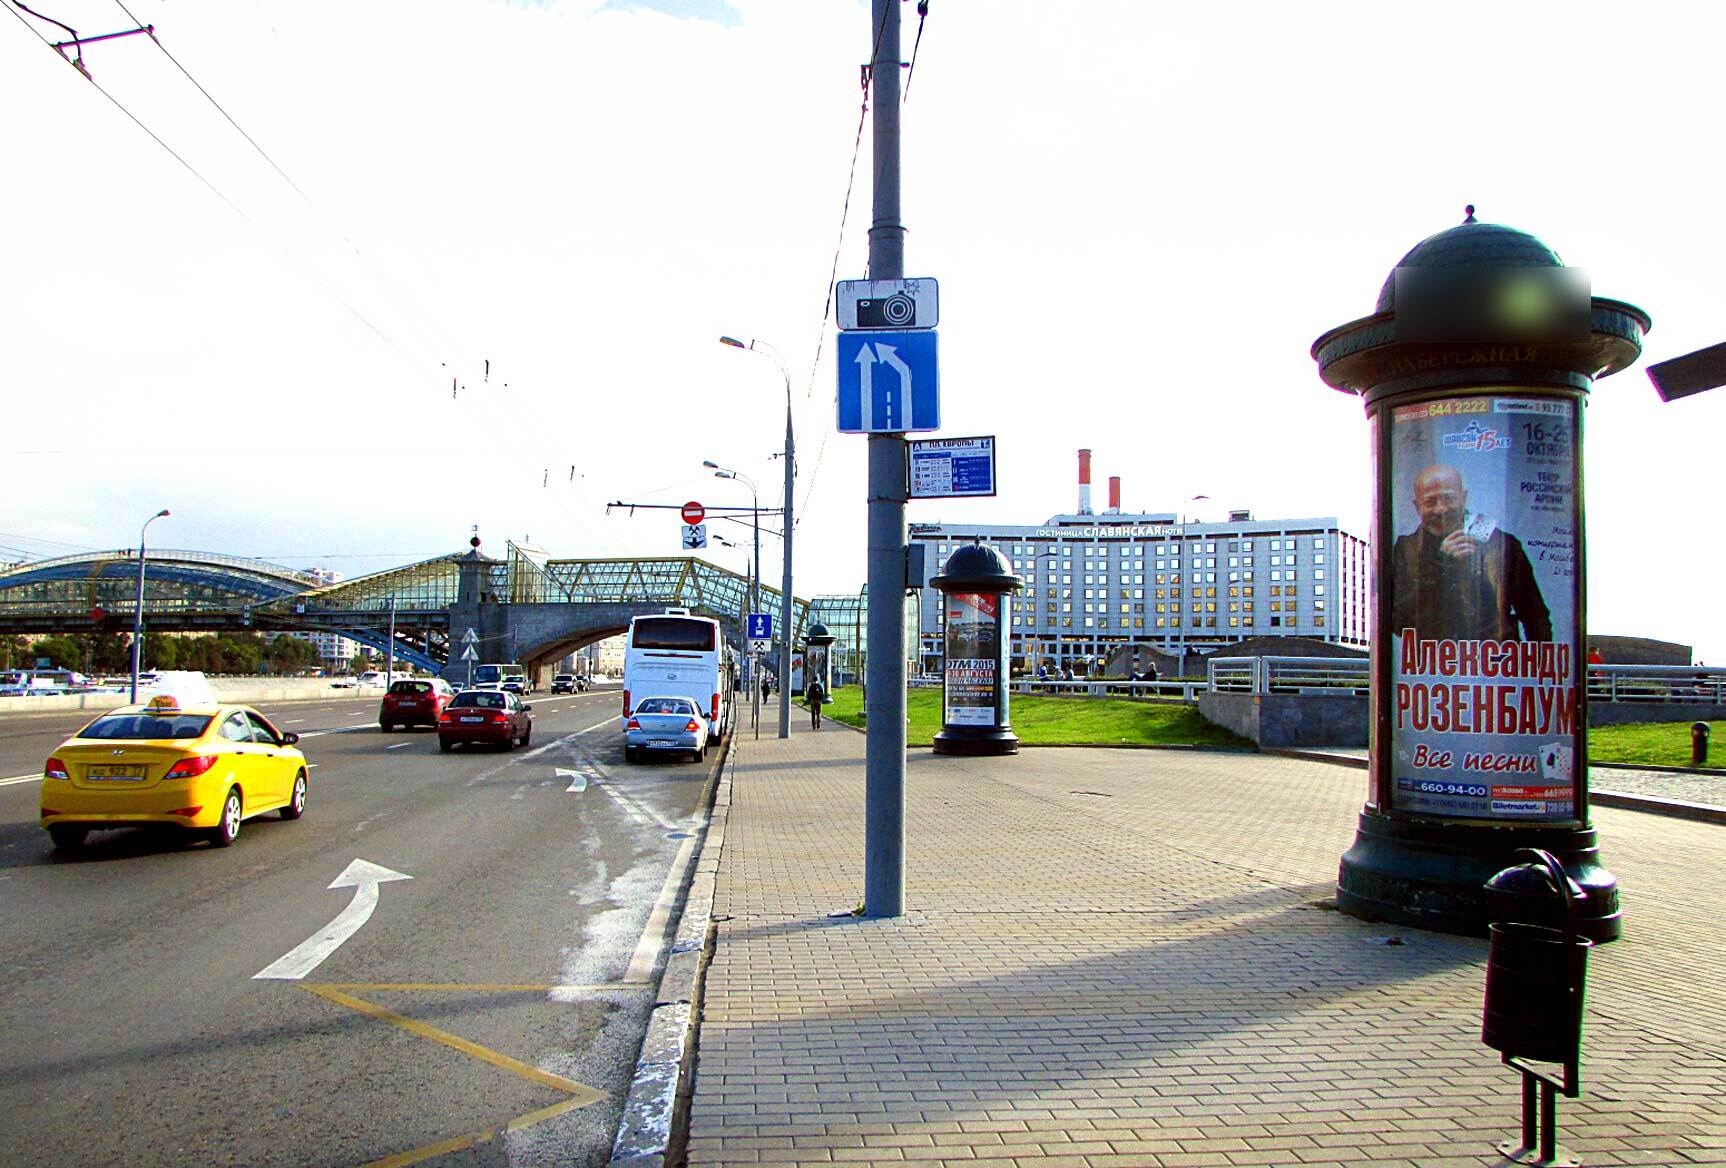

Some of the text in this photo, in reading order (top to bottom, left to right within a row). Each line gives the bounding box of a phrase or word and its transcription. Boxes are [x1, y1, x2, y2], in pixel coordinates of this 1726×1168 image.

[1036, 528, 1083, 538] ГОСТИНИЦА
[1083, 525, 1162, 538] СЛАВЯНСКАЯ
[973, 660, 994, 669] 2015
[1401, 628, 1570, 686] Александр
[1396, 683, 1576, 735] РОЗЕНБАУМ
[1413, 744, 1453, 769] Все
[1463, 752, 1537, 773] песни
[1421, 782, 1486, 797] 660-94-00
